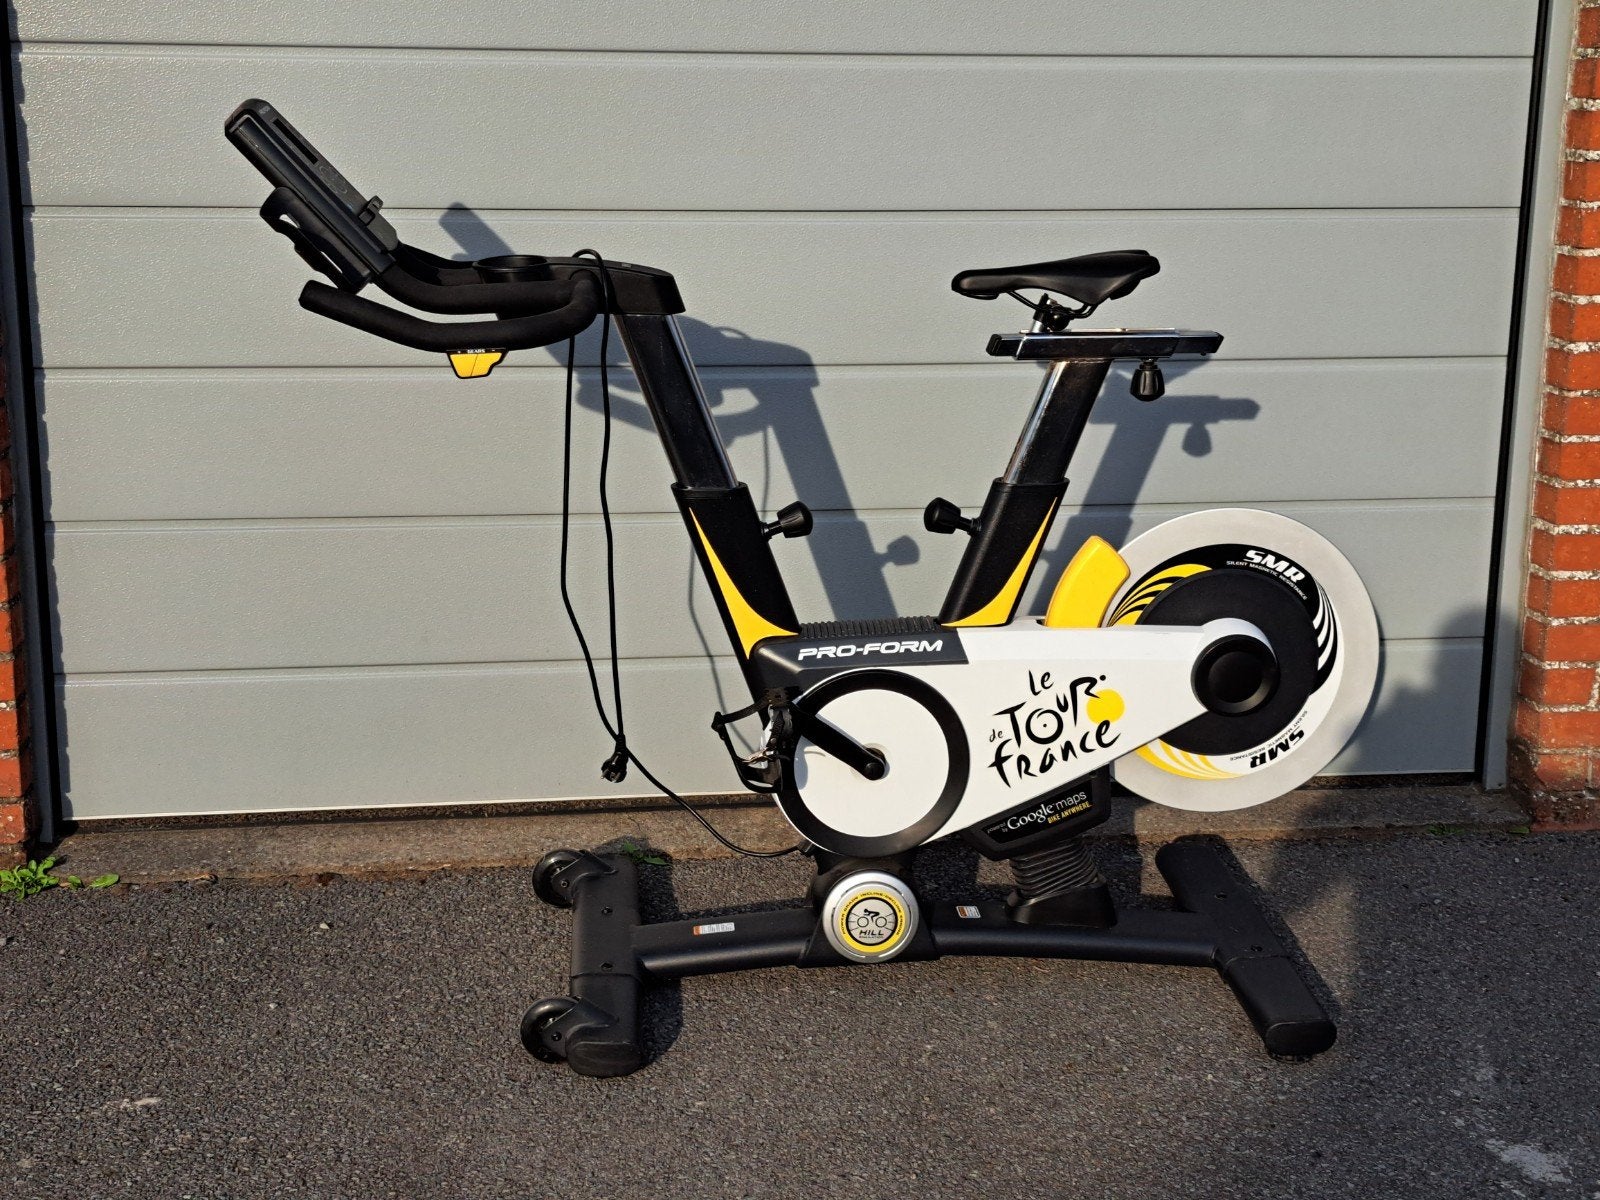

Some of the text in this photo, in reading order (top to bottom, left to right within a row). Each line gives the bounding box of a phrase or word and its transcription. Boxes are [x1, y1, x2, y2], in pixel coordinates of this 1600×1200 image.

[1243, 549, 1305, 583] SMR
[1249, 563, 1279, 577] MAGNETIC
[1279, 574, 1308, 601] RESISTANCE
[798, 639, 944, 661] PRO-FORM
[989, 728, 1004, 743] de
[1250, 727, 1305, 769] SMR
[1007, 791, 1087, 830] Google maps
[1047, 813, 1061, 824] BIKE
